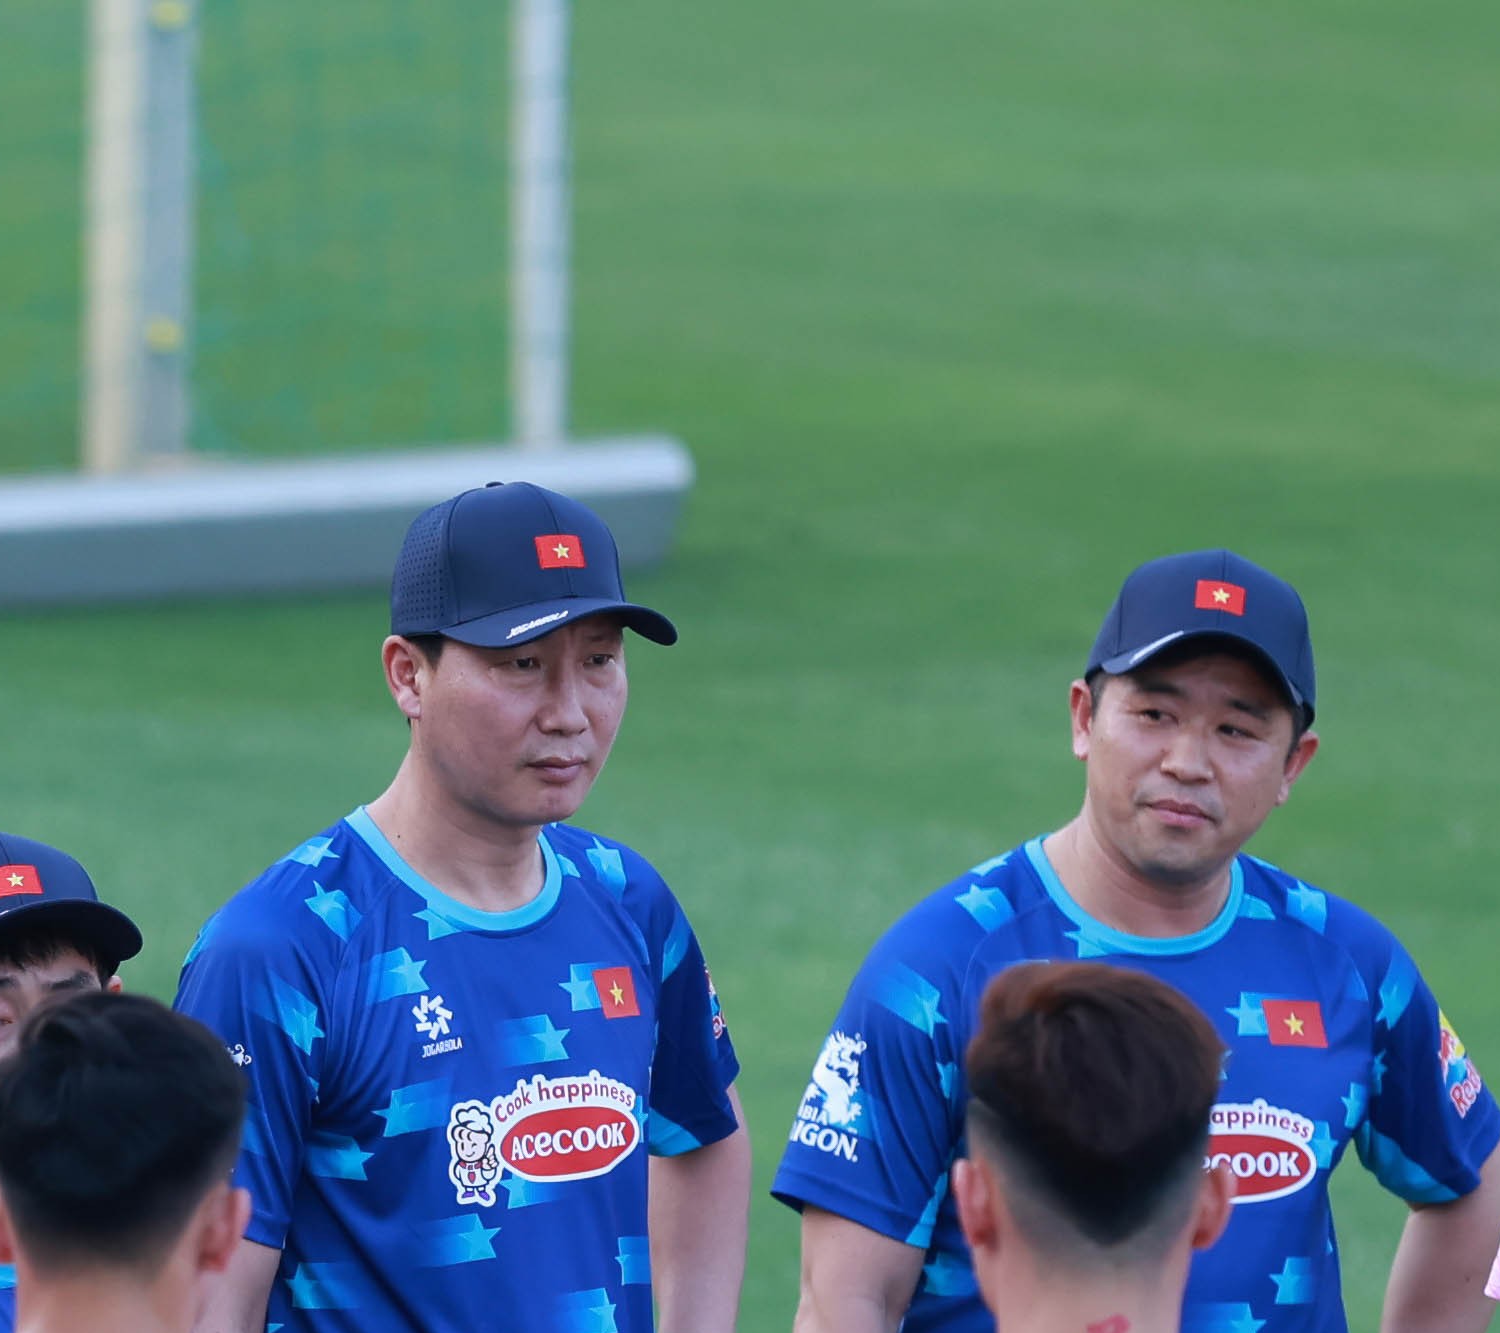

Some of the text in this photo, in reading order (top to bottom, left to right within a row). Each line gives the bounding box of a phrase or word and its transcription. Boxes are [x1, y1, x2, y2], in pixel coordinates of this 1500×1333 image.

[494, 1076, 633, 1123] Cook happiness
[1211, 1105, 1310, 1138] appiness
